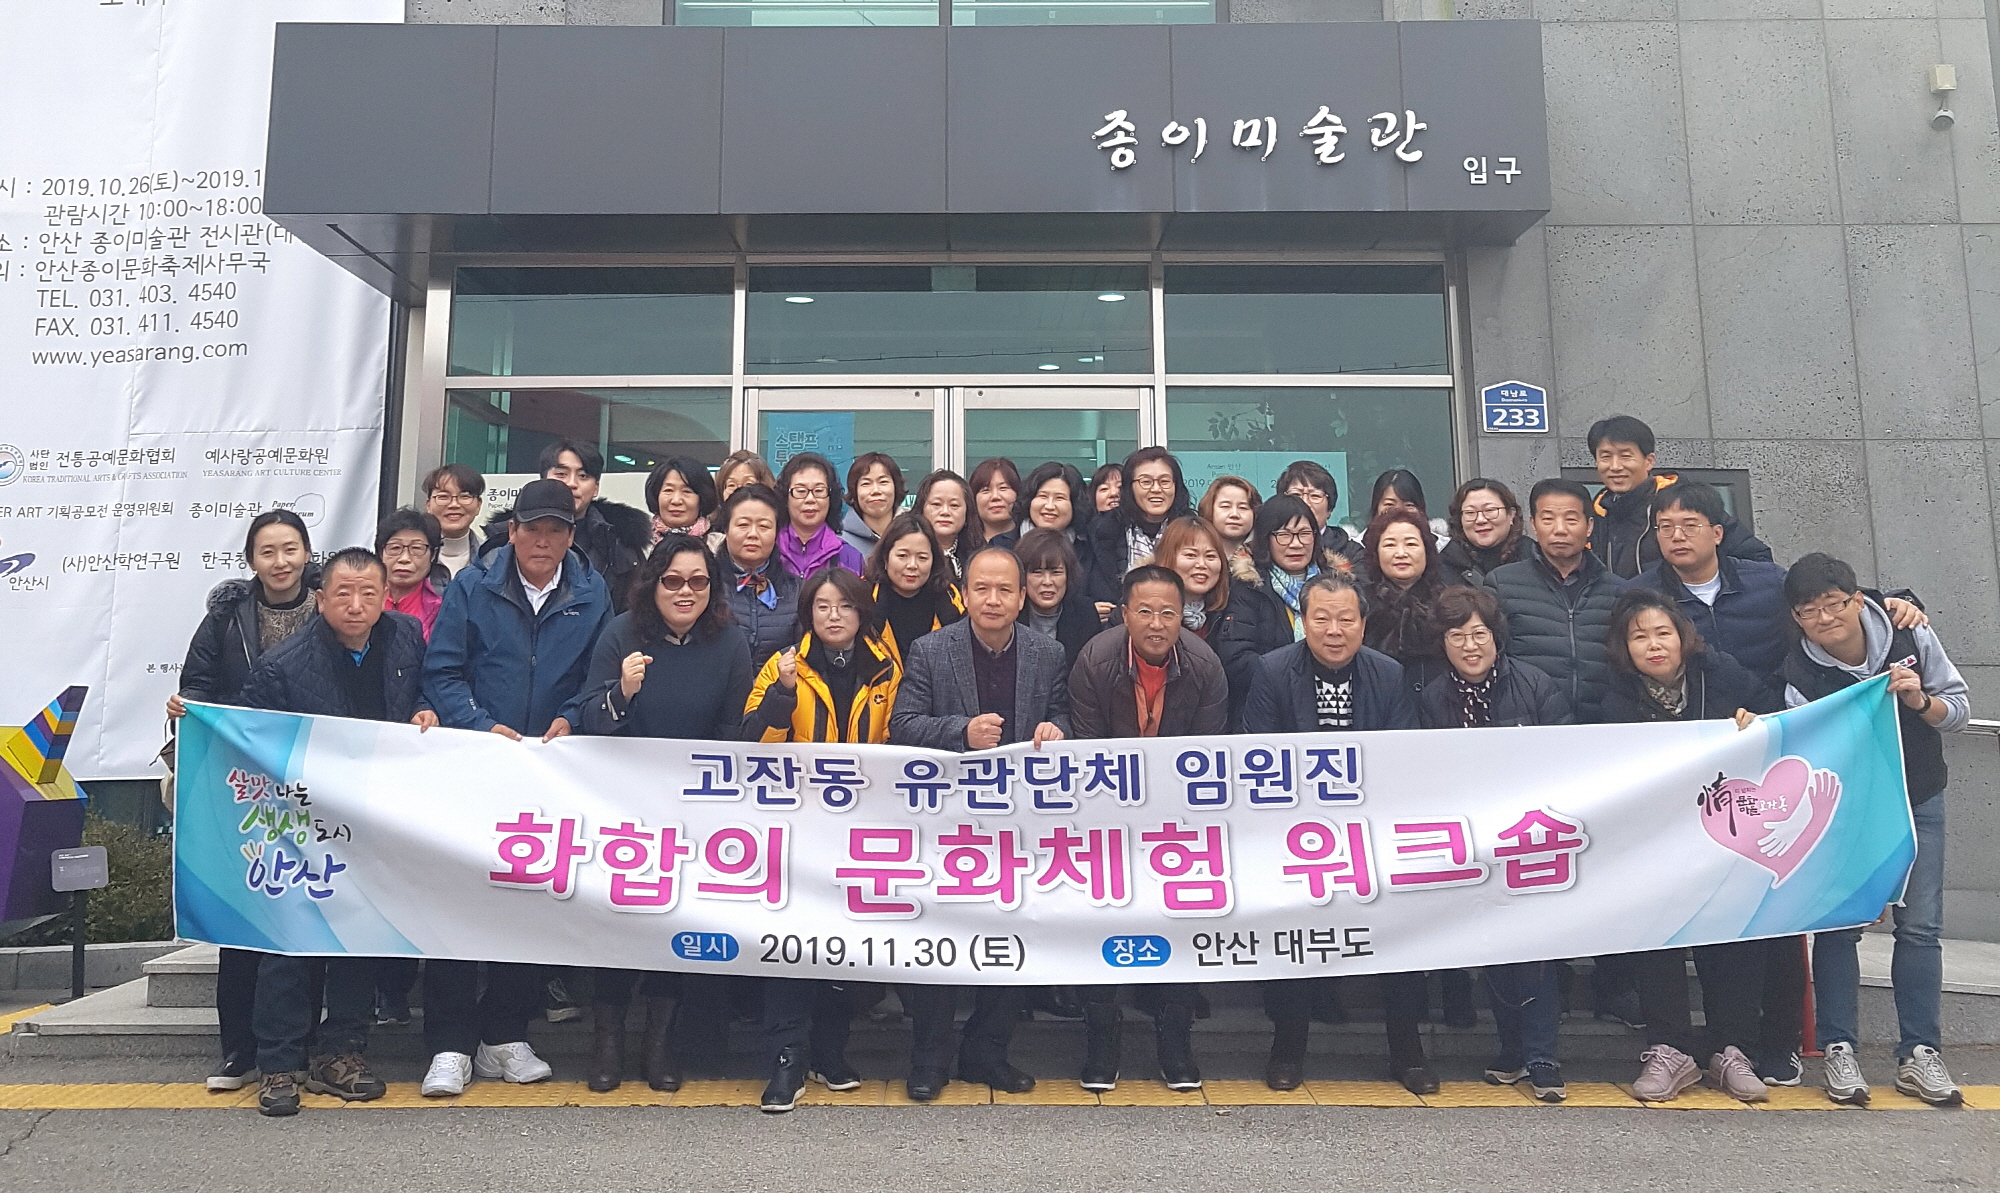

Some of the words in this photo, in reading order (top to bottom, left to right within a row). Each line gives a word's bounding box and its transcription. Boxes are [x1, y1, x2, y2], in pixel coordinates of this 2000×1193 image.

[1092, 105, 1427, 171] 종이미술관
[1463, 156, 1522, 184] 입구
[43, 203, 130, 227] 관람시간
[139, 196, 262, 220] 10:00~18:00
[39, 231, 82, 254] 안산
[90, 226, 191, 254] 종이미술관
[35, 251, 271, 282] 안산종이문화축제사무국
[37, 289, 78, 308] TEL.
[89, 288, 130, 307] 031.
[139, 284, 177, 305] 403.
[188, 281, 236, 301] 4540
[35, 317, 79, 337] FAX.
[90, 316, 130, 336] 031.
[138, 313, 180, 333] 411.
[190, 309, 239, 329] 4540
[32, 342, 248, 368] www.yeasarang.com
[1492, 408, 1540, 427] 233
[775, 431, 819, 450] 스탬프
[30, 449, 50, 459] 사단
[30, 461, 49, 470] 법인
[56, 446, 176, 468] 전통공예문화협회
[205, 447, 329, 465] 예사랑공예문화원
[23, 475, 45, 483] KOREA
[202, 469, 253, 477] YEASARANG
[273, 468, 311, 476] CULTURE
[313, 468, 342, 476] CENTER
[17, 506, 43, 518] ART
[47, 503, 108, 519] 기획공모전
[111, 501, 174, 517] 운영위원회
[189, 501, 262, 518] 종이미술관
[272, 500, 294, 510] Paper
[62, 552, 181, 573] (사)안산학연구원
[9, 576, 50, 590] 안산시
[229, 769, 270, 801] 살맛
[276, 783, 312, 806] 나는
[683, 754, 865, 809] 고잔동
[896, 753, 1142, 809] 유관단체
[1176, 747, 1363, 806] 임원진
[242, 805, 310, 844] 생생
[314, 819, 352, 843] 도시
[249, 850, 347, 899] 안산
[489, 812, 784, 906] 화합의
[836, 822, 1229, 913] 문화체험
[1283, 810, 1584, 898] 워크숍
[679, 933, 730, 959] 일시
[760, 933, 957, 968] 2019.11.30
[970, 934, 1026, 971] (토)
[1112, 937, 1161, 965] 장소
[1192, 931, 1260, 967] 안산
[1273, 926, 1374, 965] 대부도
